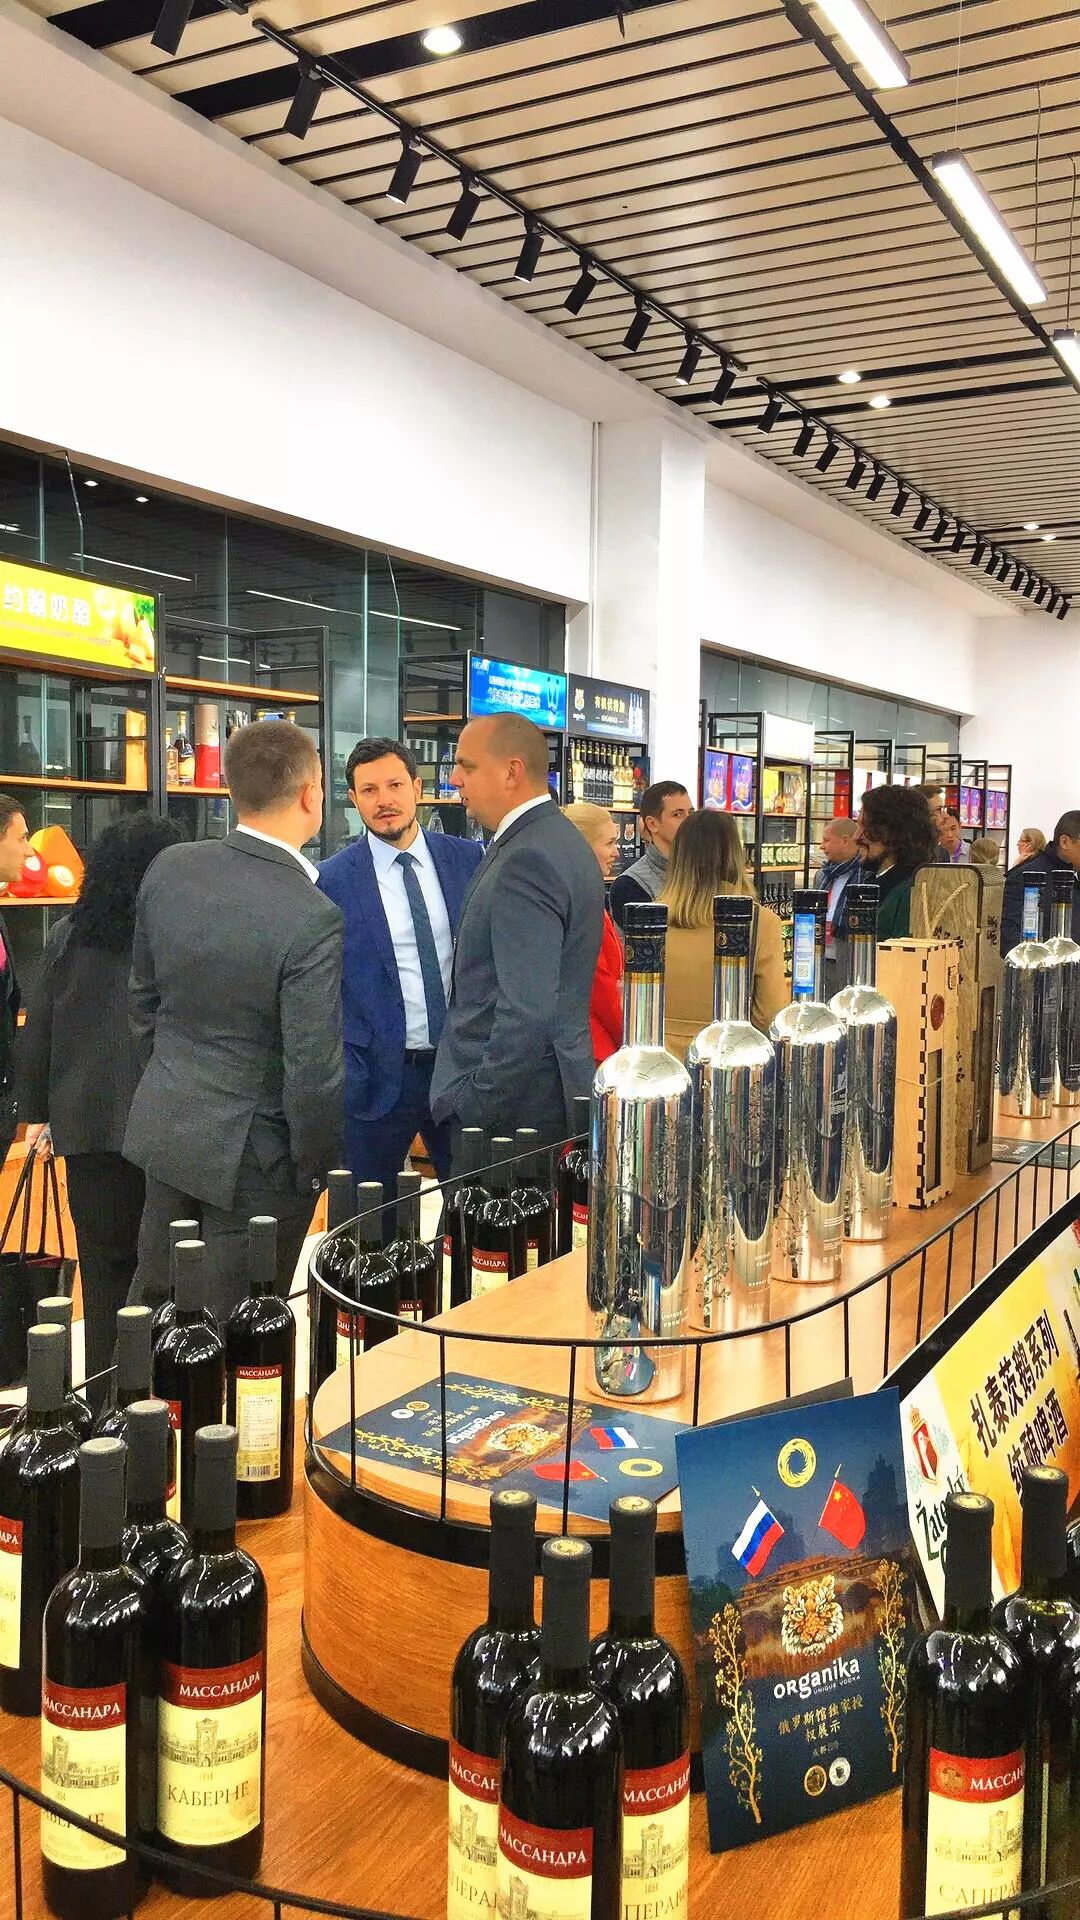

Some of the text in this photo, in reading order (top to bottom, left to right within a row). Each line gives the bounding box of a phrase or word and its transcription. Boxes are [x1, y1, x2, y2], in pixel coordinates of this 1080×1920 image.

[970, 1309, 1060, 1458] 扎泰茨鹅系列
[179, 1671, 260, 1698] МАССАНДРА
[167, 1780, 250, 1808] КАБЕРНЕ
[623, 1766, 690, 1802] МАССАНД
[500, 1825, 587, 1867] МАССАНДРА
[939, 1873, 1020, 1904] САПЕРА
